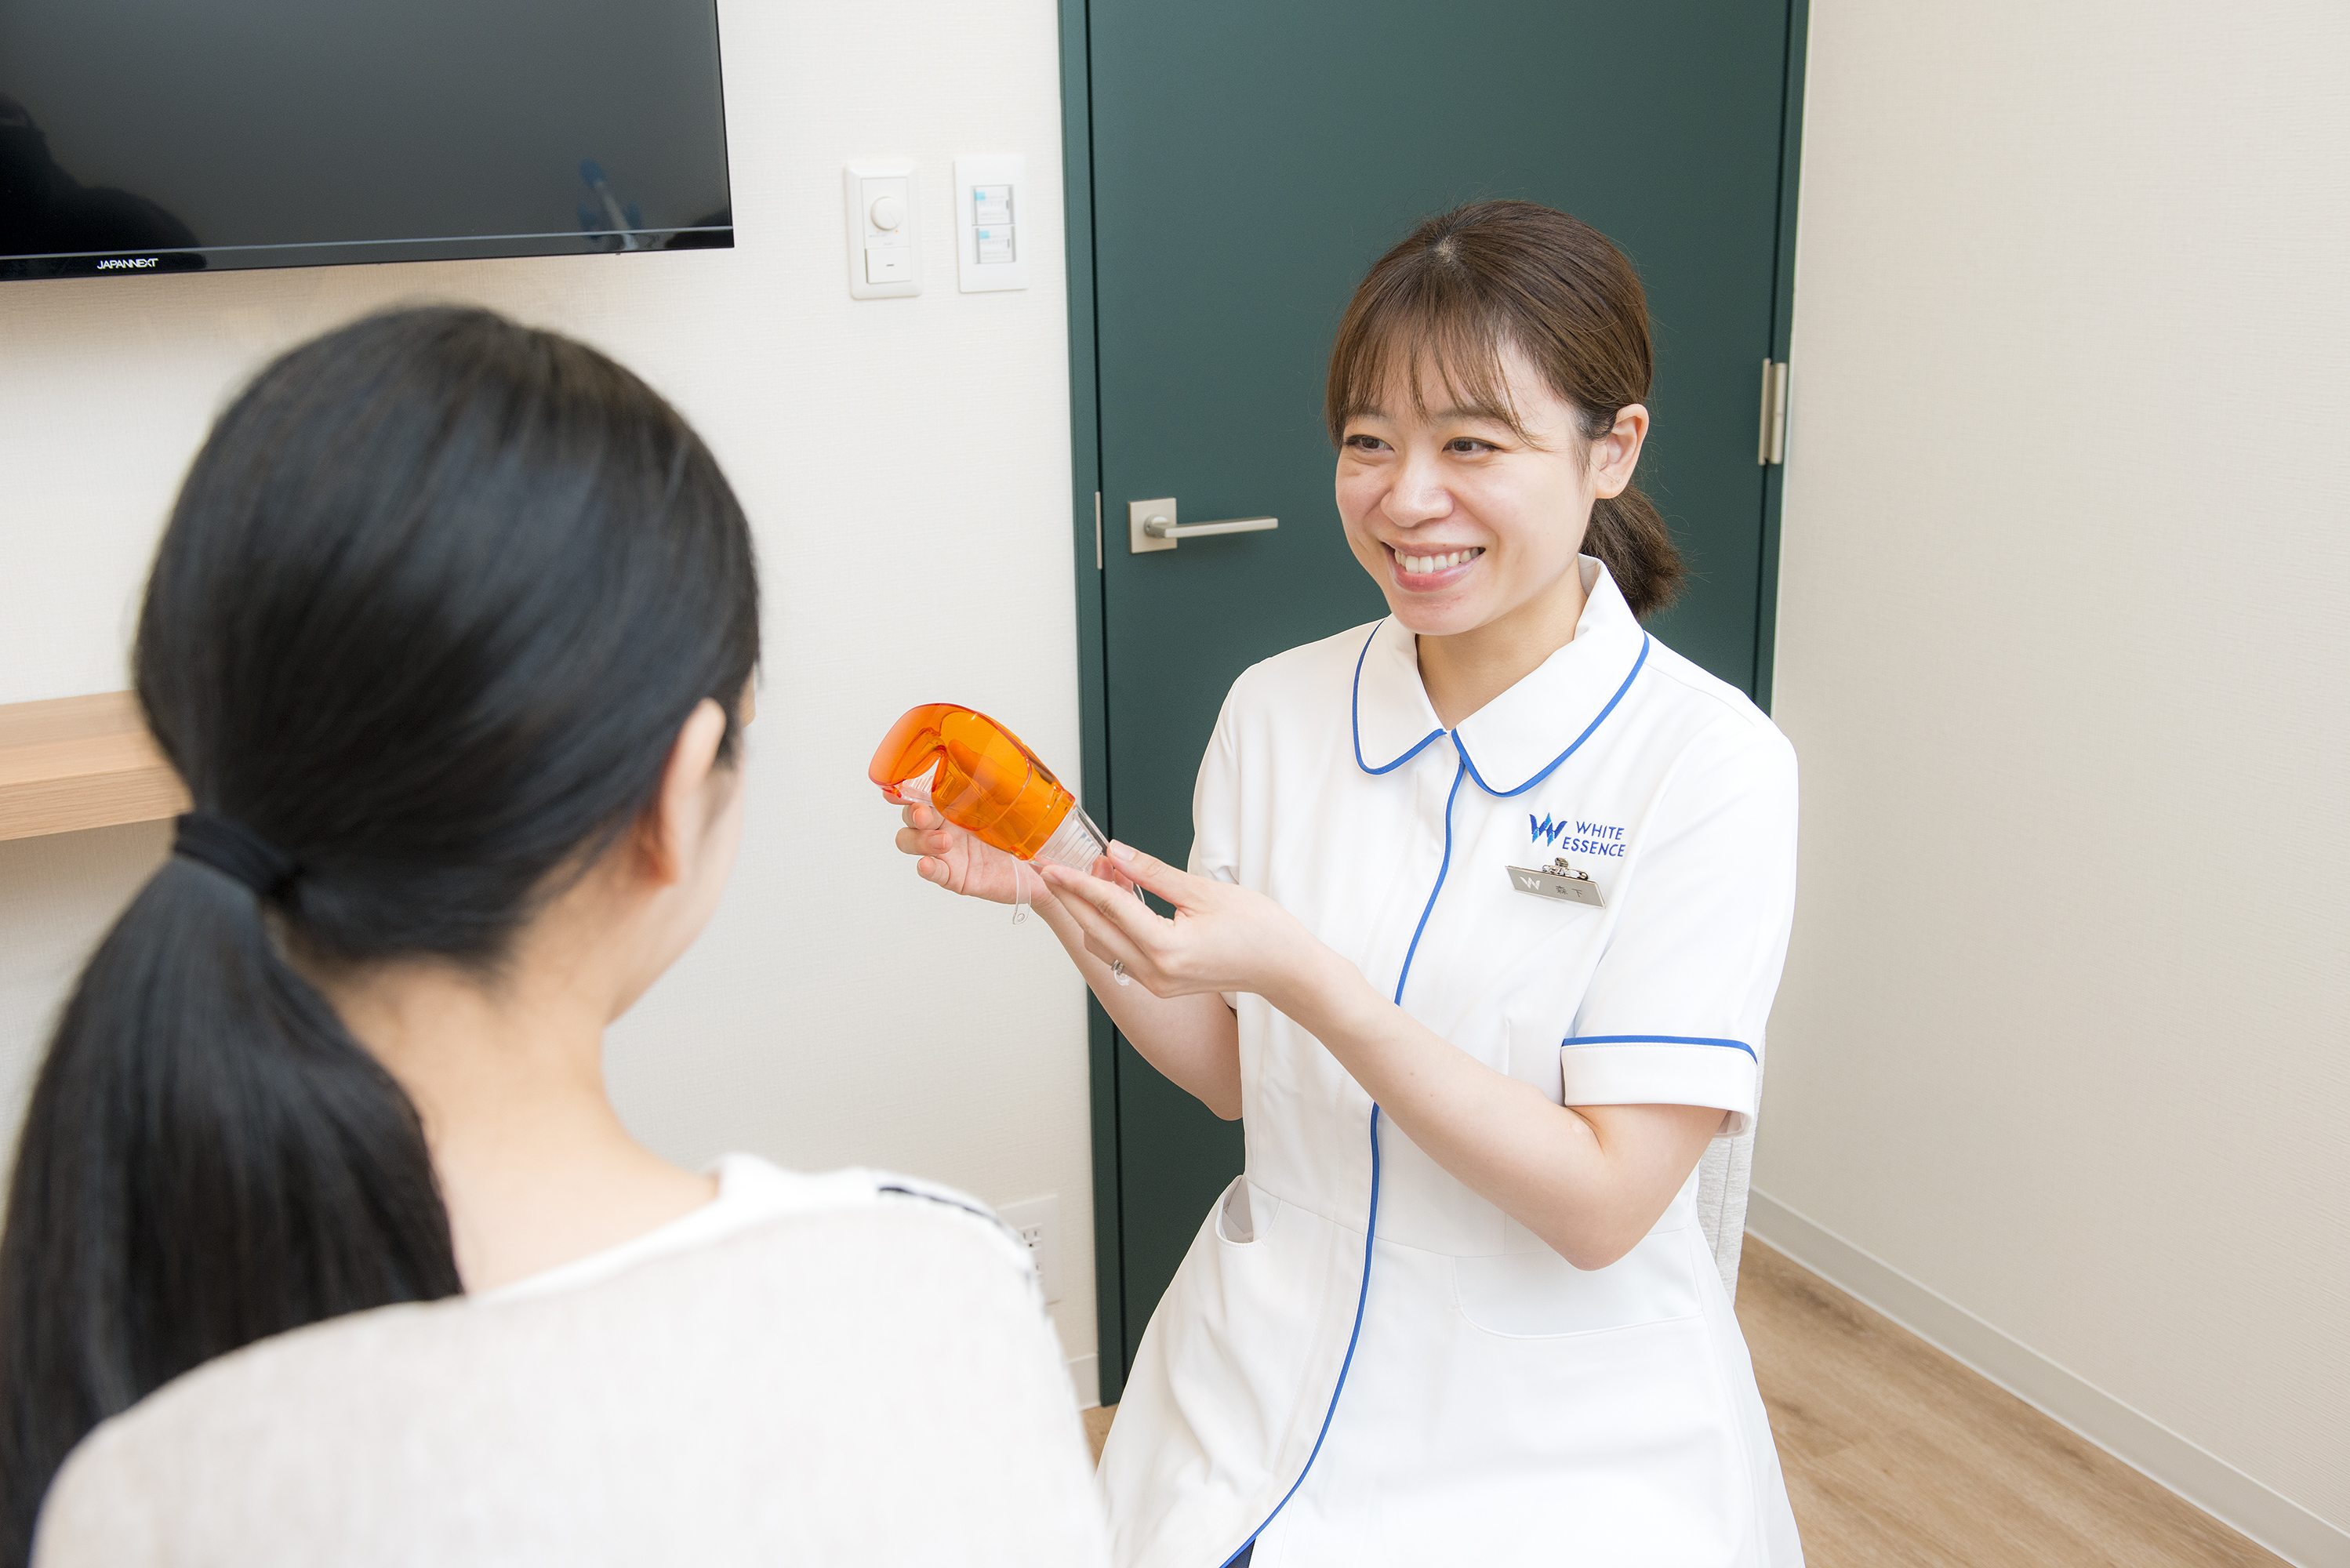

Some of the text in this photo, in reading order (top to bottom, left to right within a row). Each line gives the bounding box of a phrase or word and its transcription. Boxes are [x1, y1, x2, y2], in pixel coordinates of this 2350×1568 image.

[96, 258, 158, 269] JAPANNEXT
[1576, 821, 1625, 840] WHITE
[1562, 837, 1625, 857] ESSENCE
